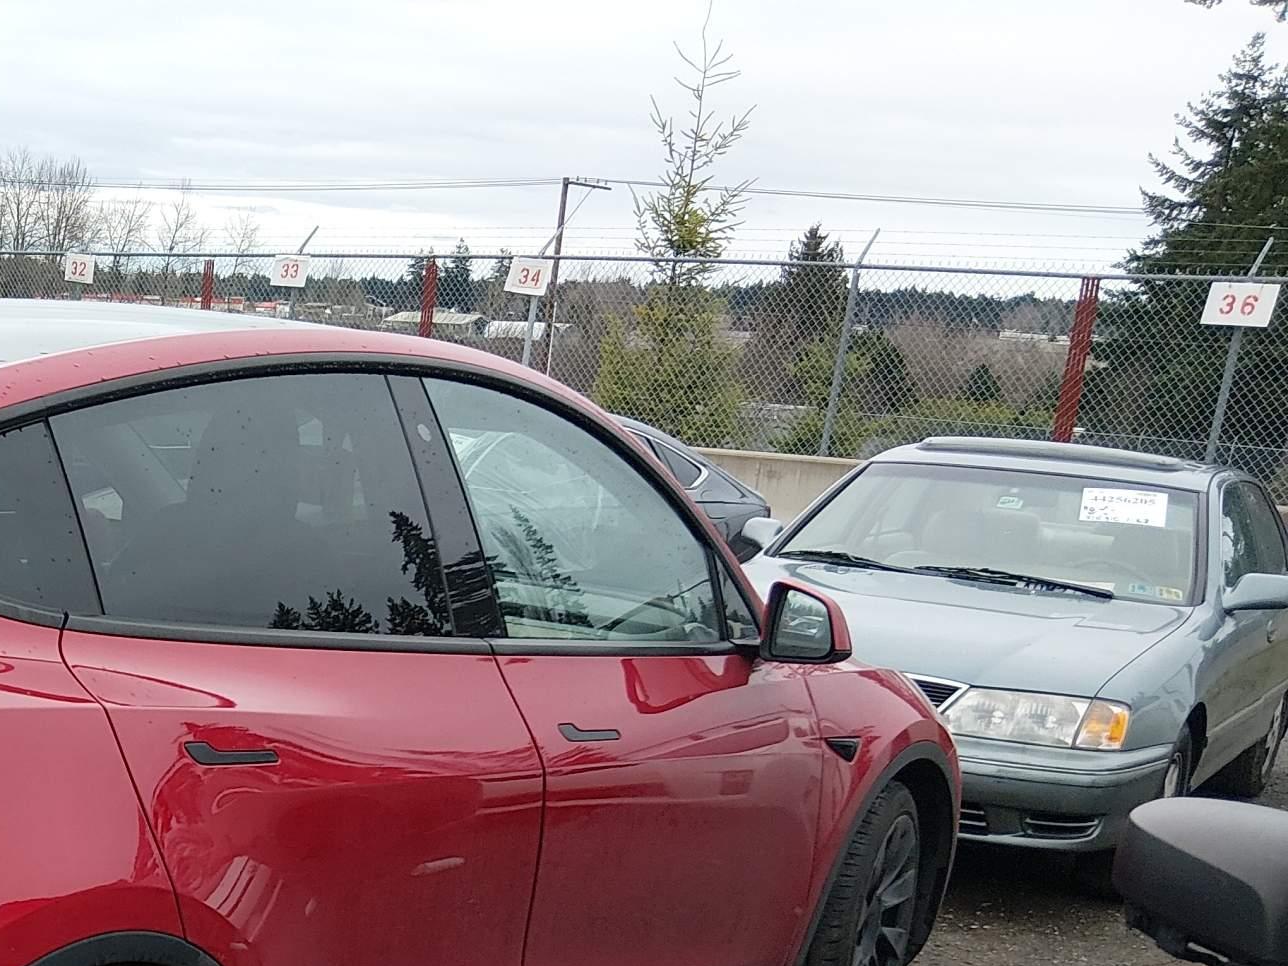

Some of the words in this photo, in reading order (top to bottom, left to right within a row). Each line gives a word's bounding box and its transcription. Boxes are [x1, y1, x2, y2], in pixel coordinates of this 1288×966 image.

[71, 261, 87, 277] 32
[280, 263, 299, 279] 33
[518, 267, 542, 287] 34
[1219, 294, 1259, 316] 36
